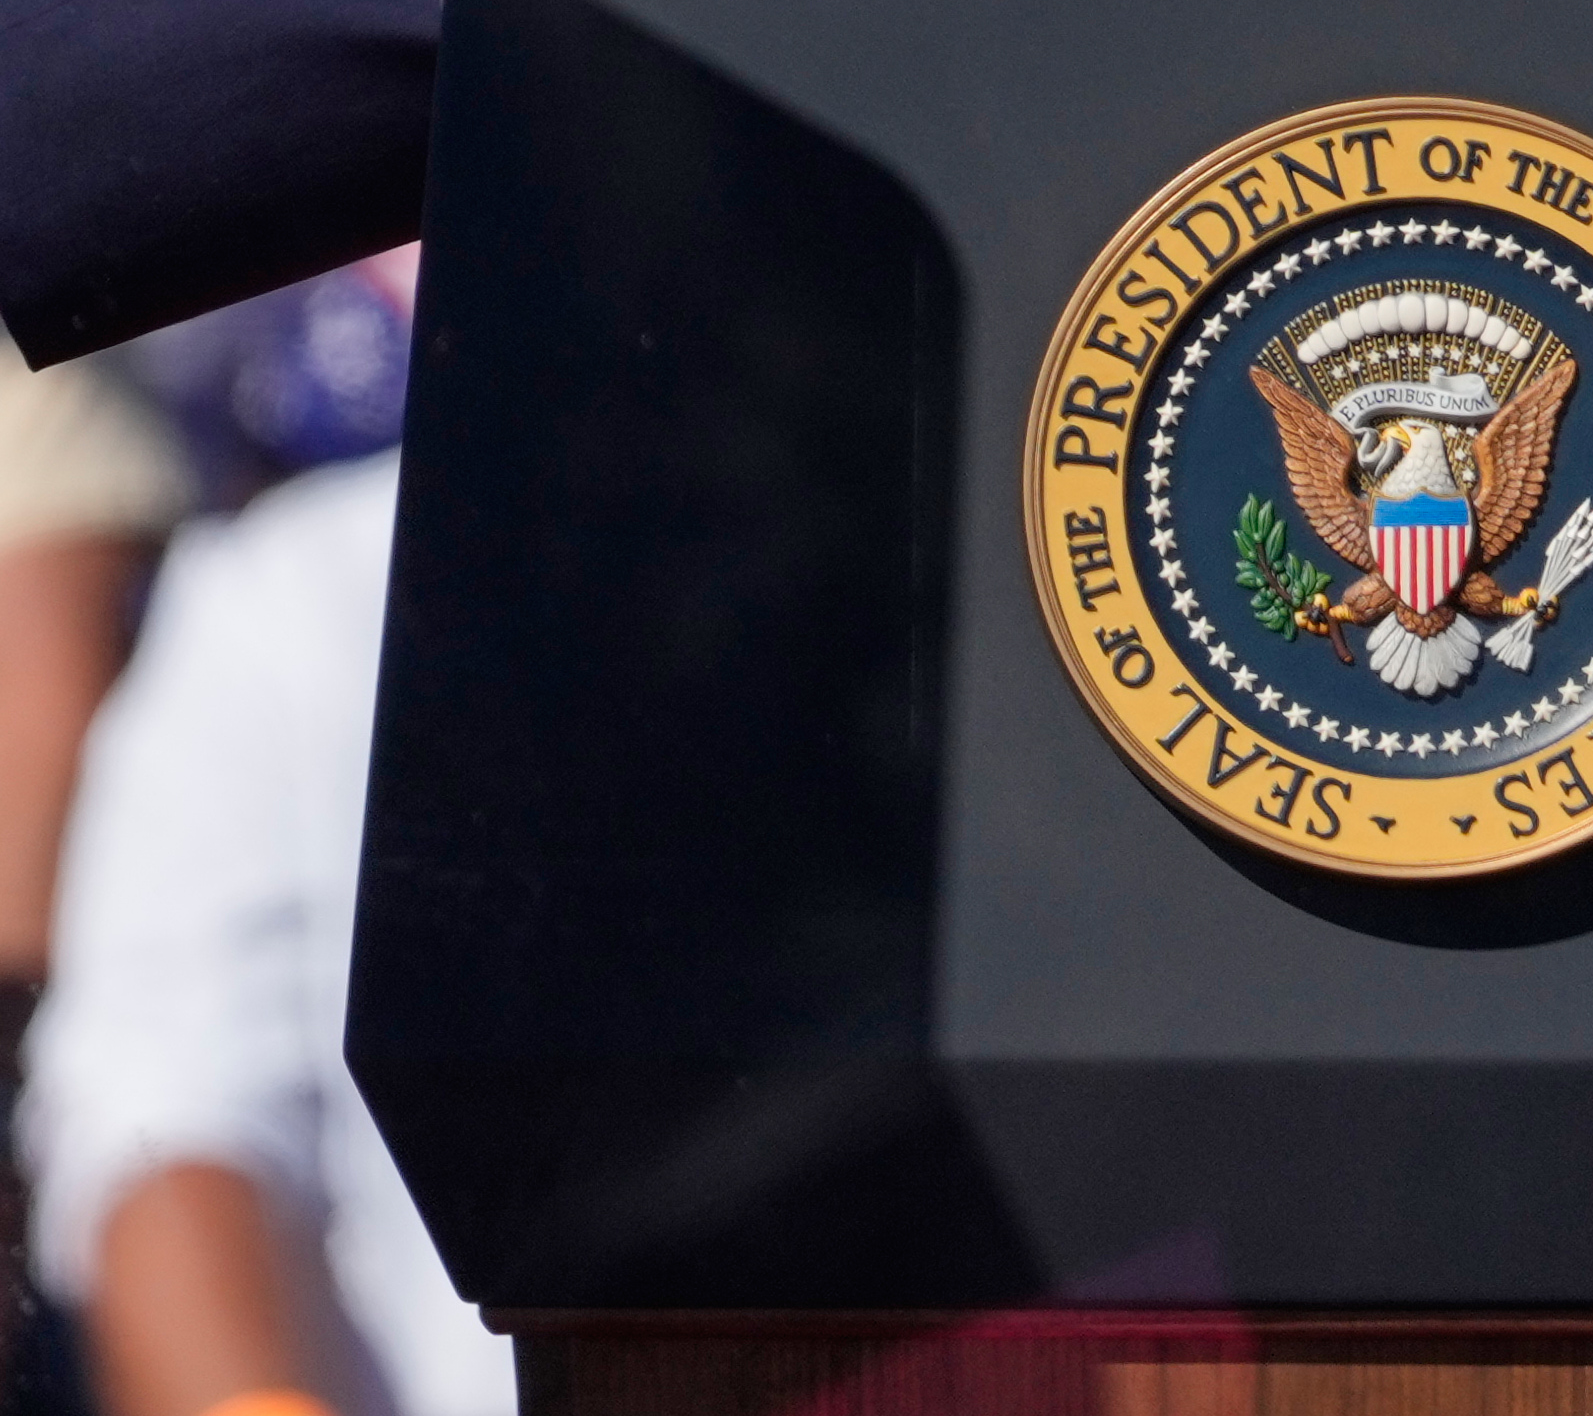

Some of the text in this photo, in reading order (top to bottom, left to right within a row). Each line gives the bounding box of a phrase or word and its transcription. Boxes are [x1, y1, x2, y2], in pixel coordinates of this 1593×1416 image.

[1419, 135, 1492, 184] OF
[1054, 126, 1394, 475] PRESIDENT
[1338, 388, 1491, 423] E PLURIBUS UNUM
[1062, 505, 1121, 613] THE
[1093, 624, 1155, 689] OF
[1155, 682, 1353, 840] SEAL
